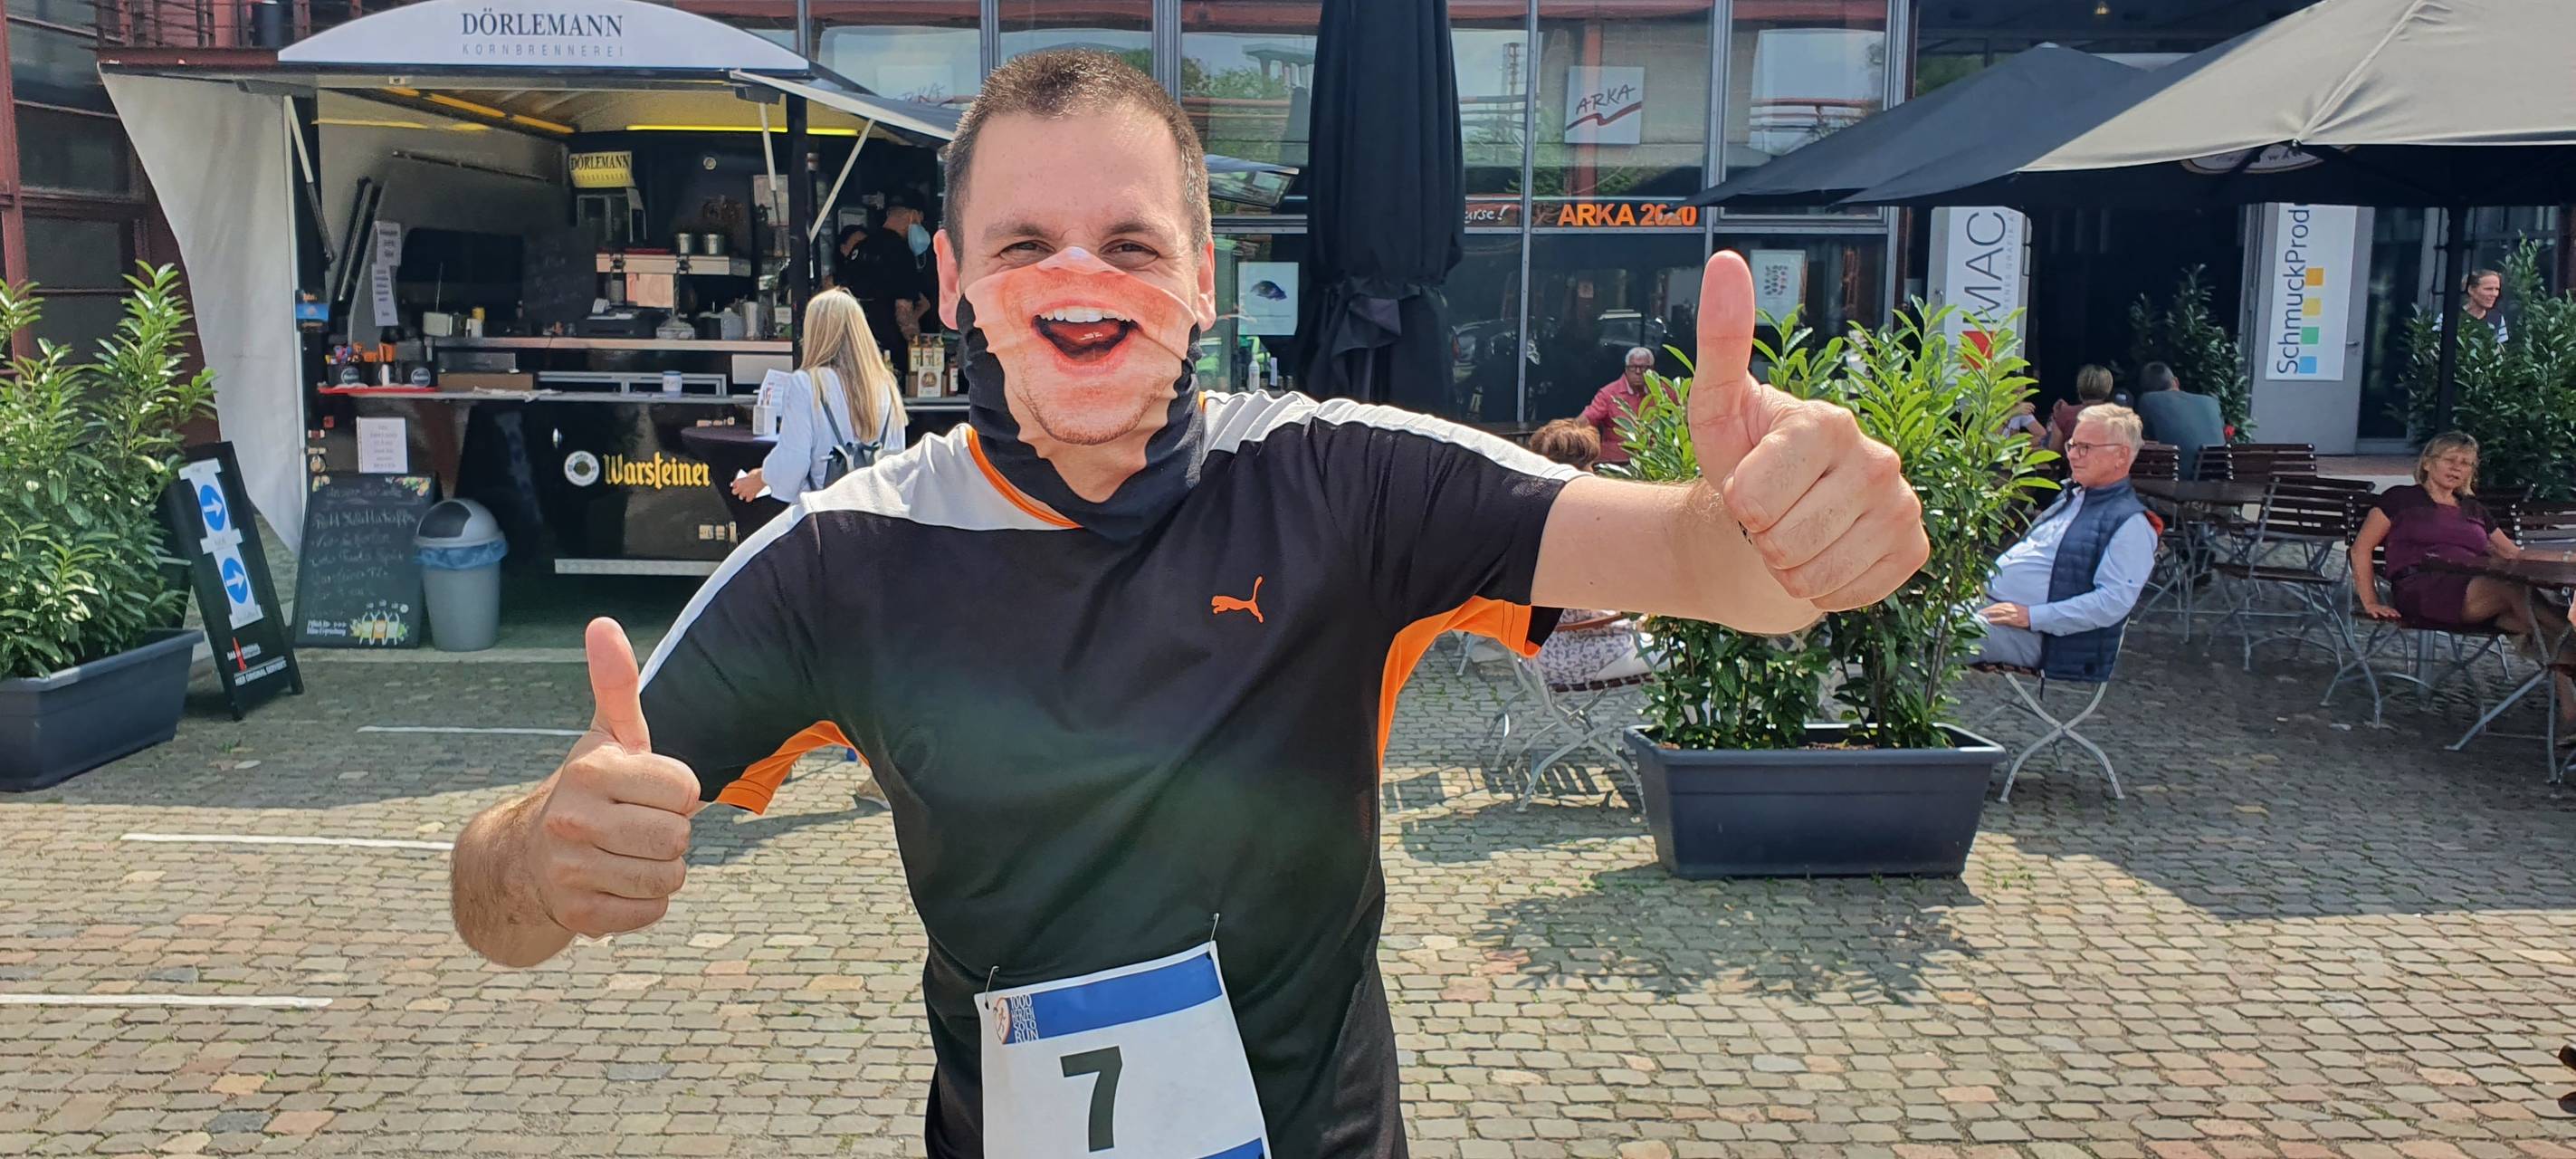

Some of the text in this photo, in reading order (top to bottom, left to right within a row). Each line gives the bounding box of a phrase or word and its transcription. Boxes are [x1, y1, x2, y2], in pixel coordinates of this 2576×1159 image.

[461, 7, 623, 37] DÖRLEMANN
[463, 43, 623, 57] KORNBRENNEREI
[1576, 84, 1636, 115] ARKA
[1465, 205, 1510, 224] urse!
[1558, 203, 1636, 226] ARKA
[2276, 207, 2310, 374] SchmuckProd
[603, 451, 711, 490] Warsteiner
[1010, 994, 1033, 1010] 1000
[1013, 1020, 1037, 1032] SOLO
[1015, 1029, 1039, 1043] RUN
[1060, 1045, 1122, 1153] 7
